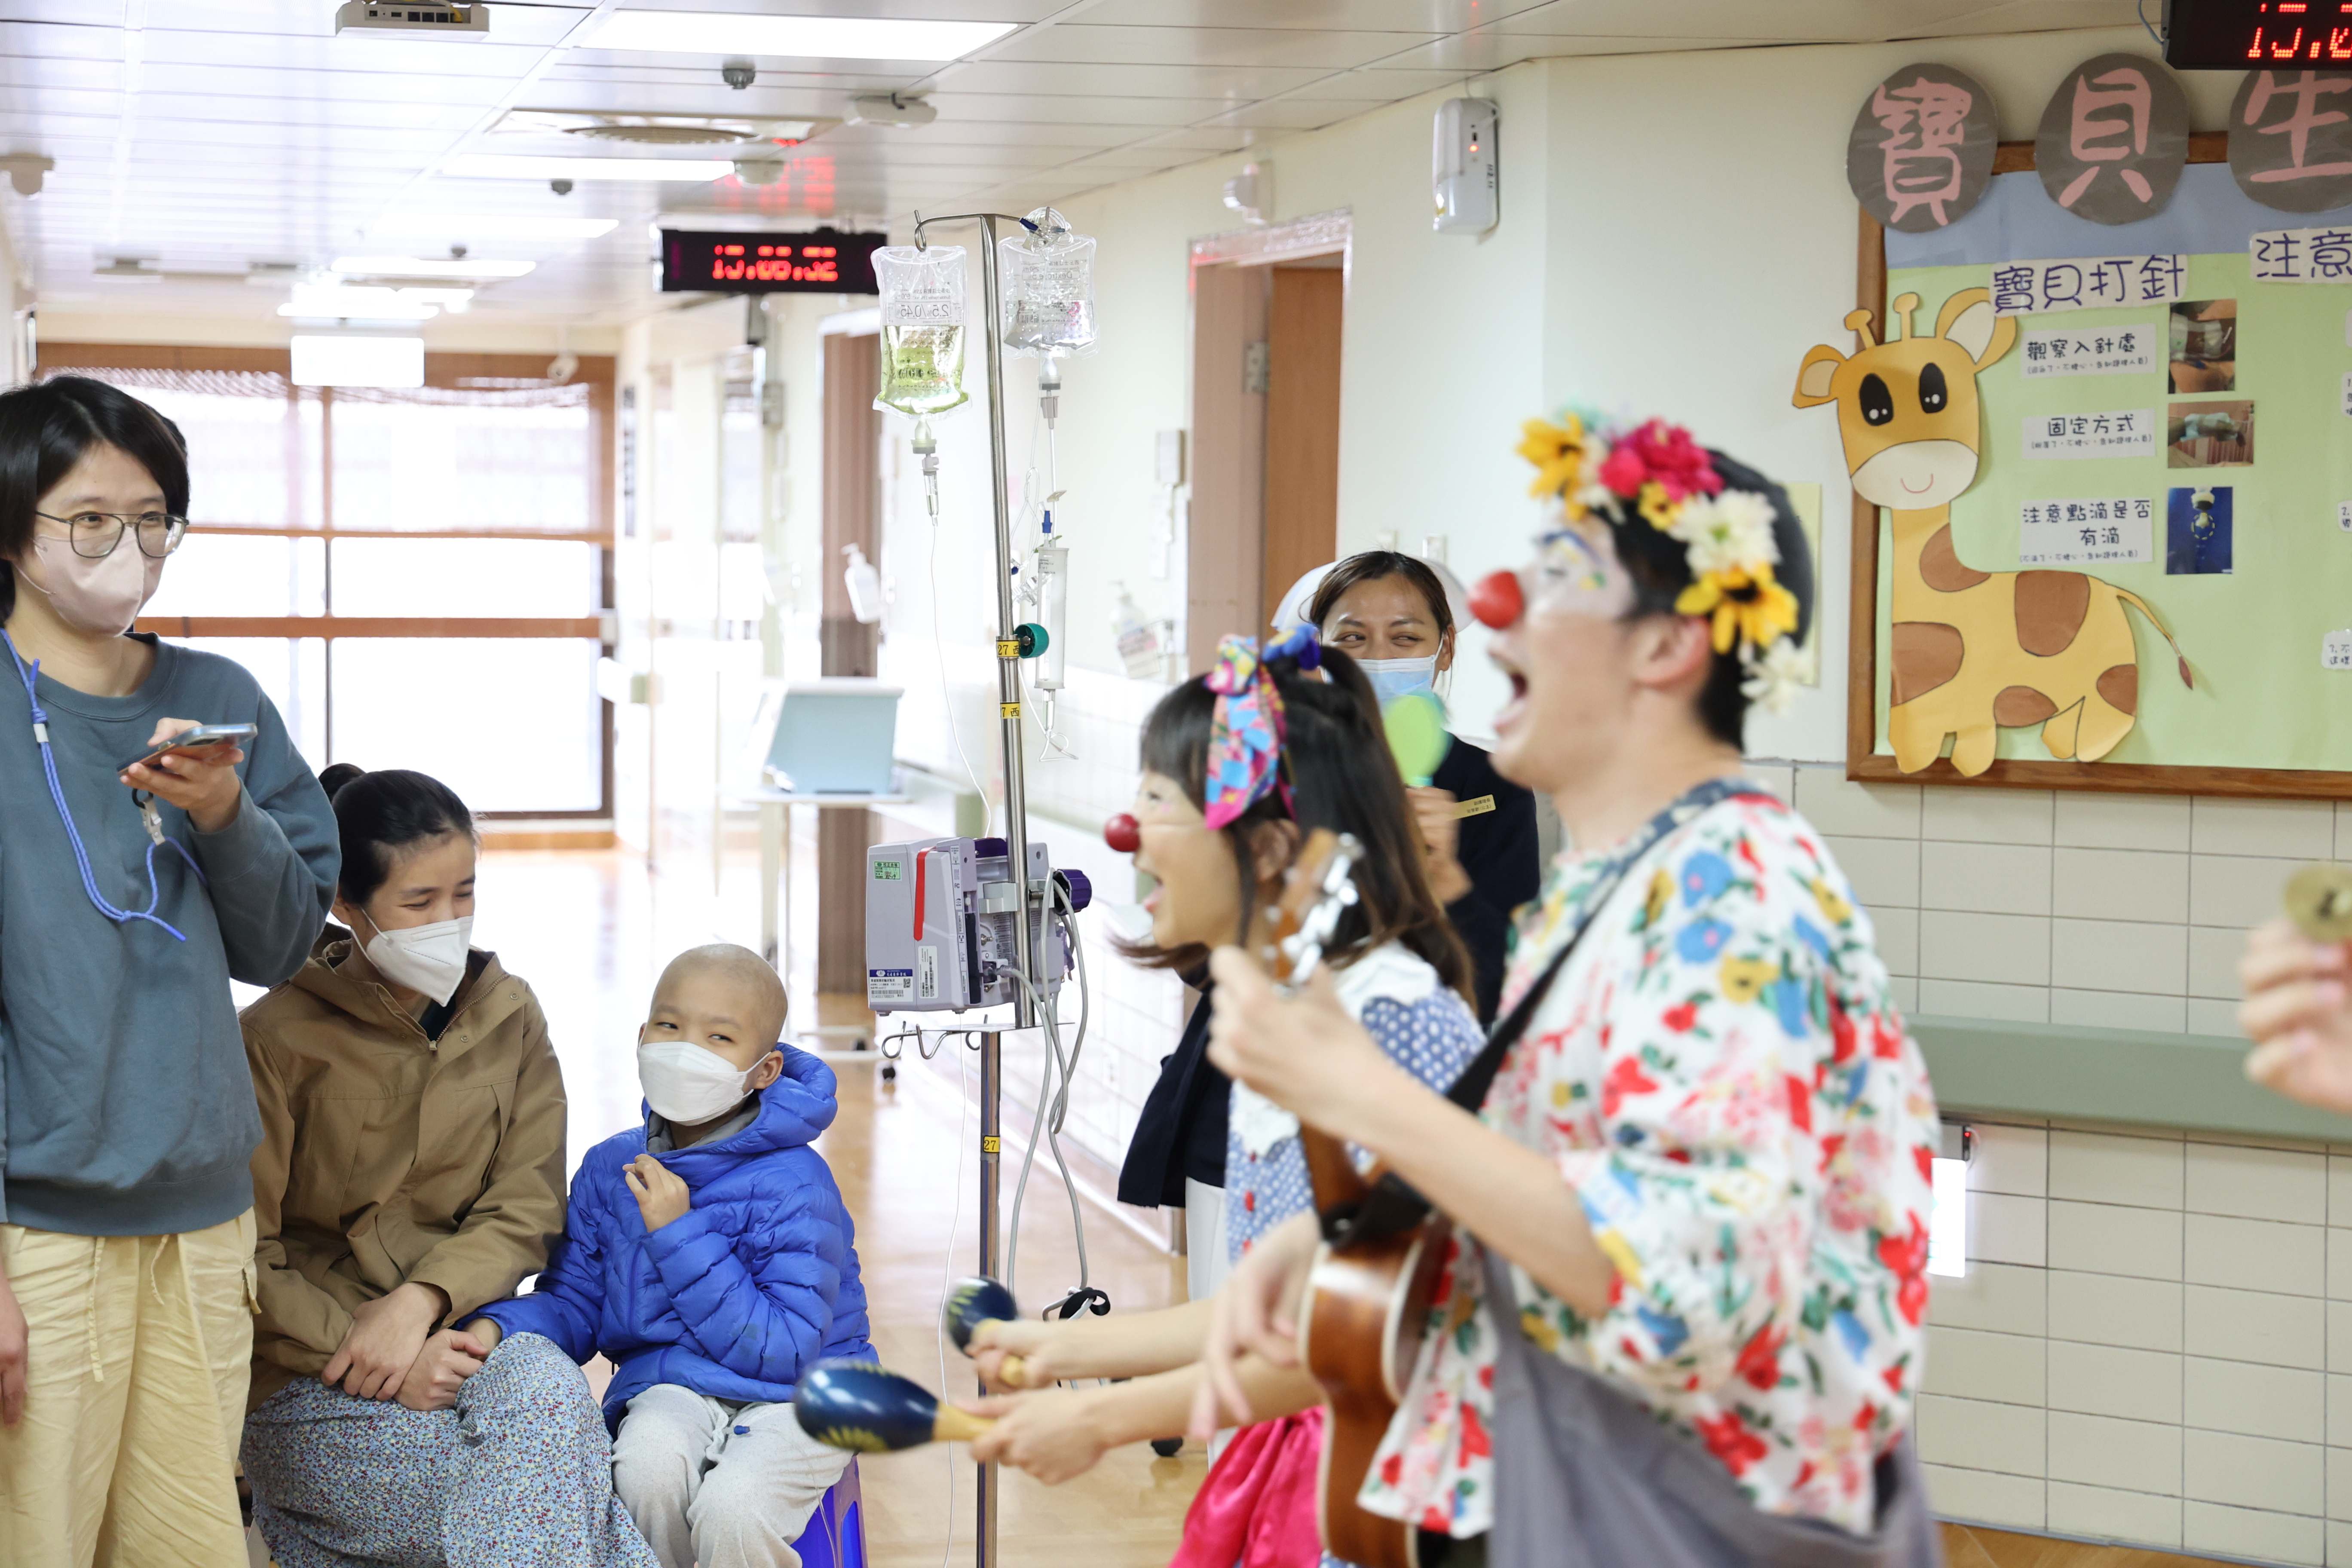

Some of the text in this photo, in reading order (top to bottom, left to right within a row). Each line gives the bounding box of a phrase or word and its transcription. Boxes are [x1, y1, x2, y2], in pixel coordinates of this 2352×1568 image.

[2256, 232, 2352, 279] 注意
[1993, 254, 2184, 313] 寶貝打針
[2027, 333, 2135, 360] 觀察入針處
[2049, 414, 2133, 436] 固定方式
[2023, 500, 2150, 523] 注意點滴是否
[2080, 526, 2119, 545] 有滴
[998, 644, 1008, 655] 27
[1011, 707, 1019, 717] 西
[984, 1140, 996, 1150] 27
